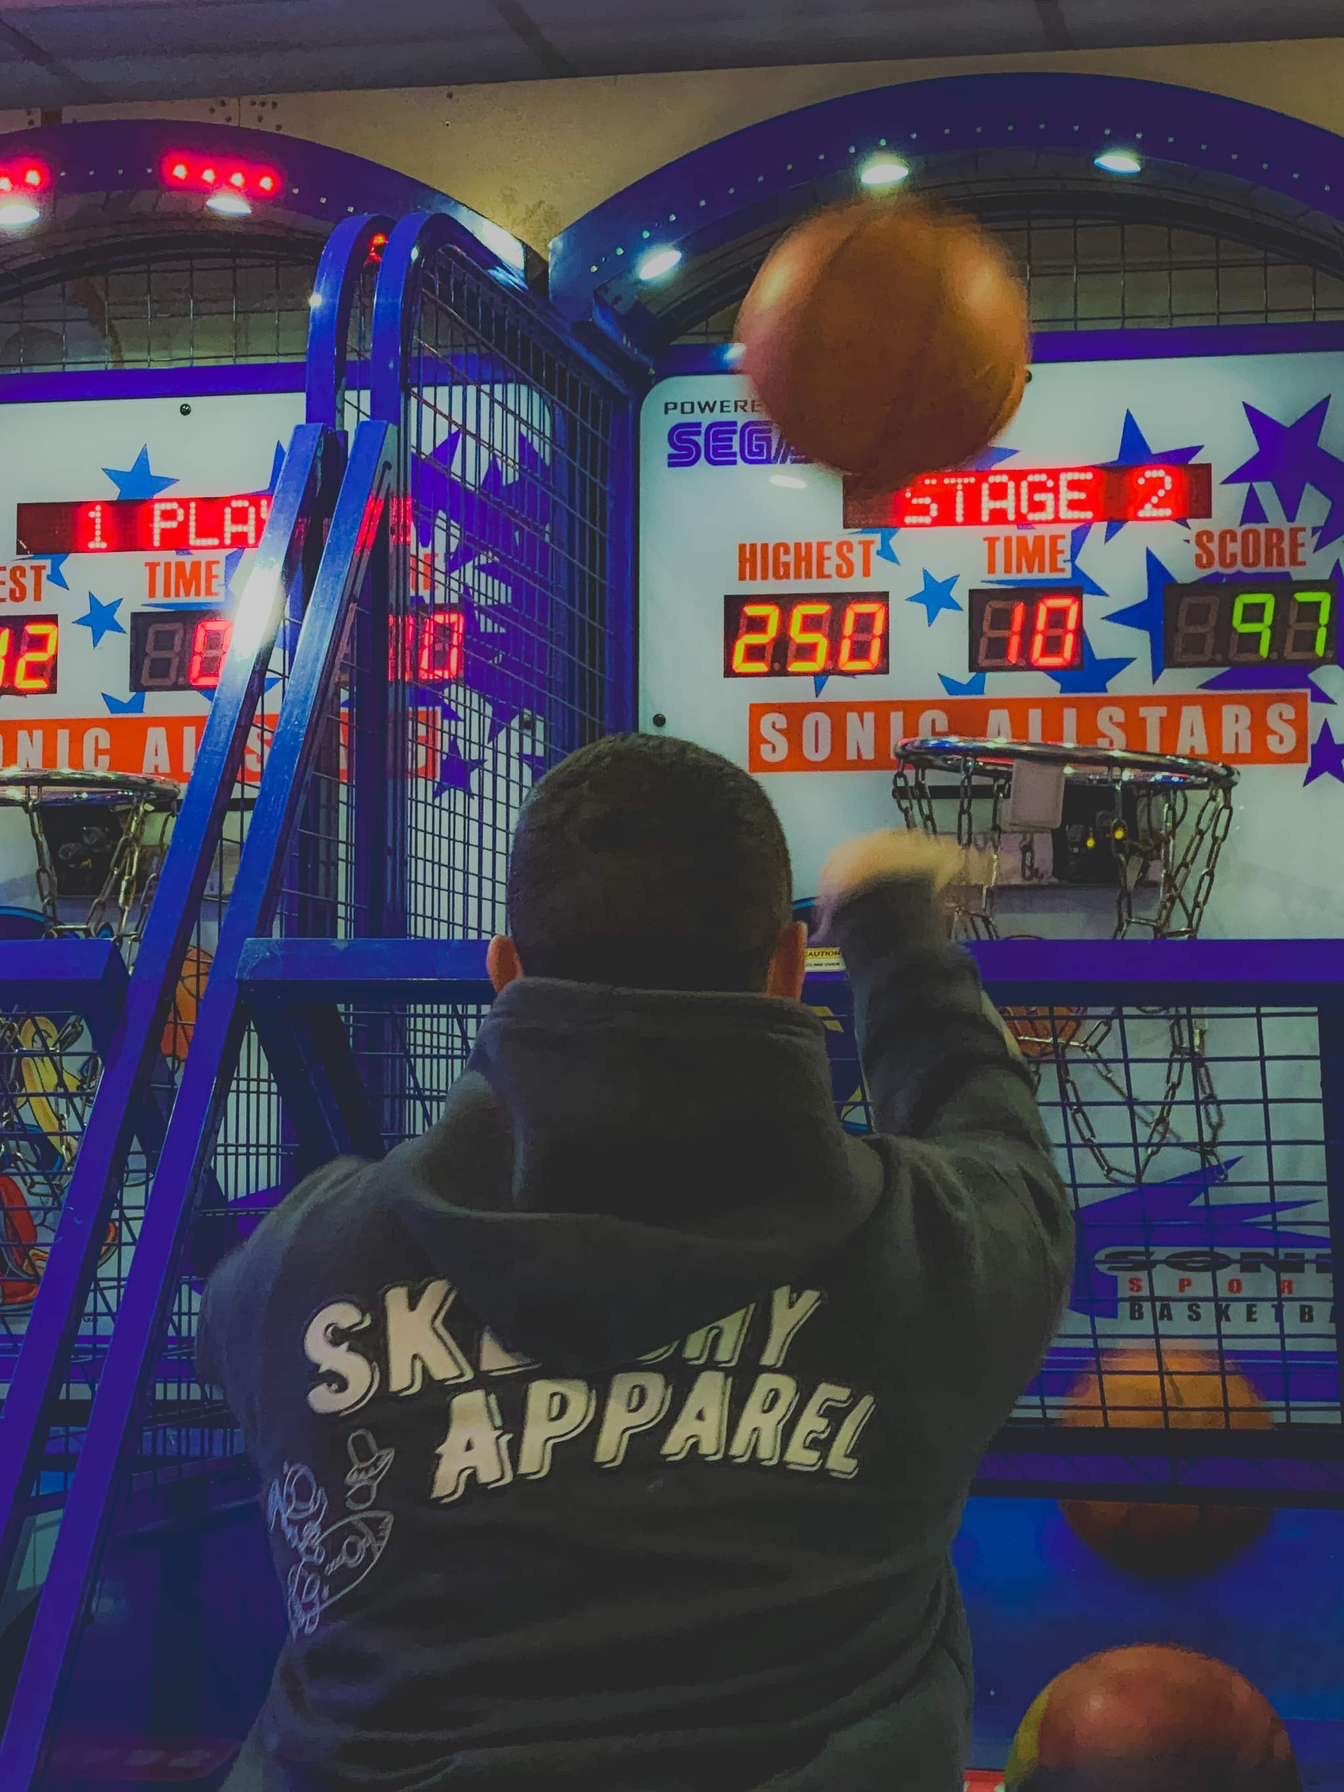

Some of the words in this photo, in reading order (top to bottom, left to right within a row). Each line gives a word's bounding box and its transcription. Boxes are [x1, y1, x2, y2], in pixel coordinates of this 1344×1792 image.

[664, 399, 762, 415] POWERE
[903, 472, 1093, 525] STAGE
[1136, 470, 1173, 517] 2
[88, 504, 108, 550] 1
[151, 498, 272, 549] PLA
[1194, 527, 1307, 569] SCORE
[144, 559, 222, 599] TIME
[737, 539, 875, 582] HIGHEST
[984, 533, 1067, 576] TIME
[731, 600, 887, 674] 250
[1007, 595, 1080, 668] 10
[1231, 590, 1333, 660] 97
[759, 708, 950, 763] SONIC
[986, 702, 1297, 757] ALLSTARS
[1129, 1302, 1334, 1323] BASKETB
[431, 1370, 877, 1503] APPAREL
